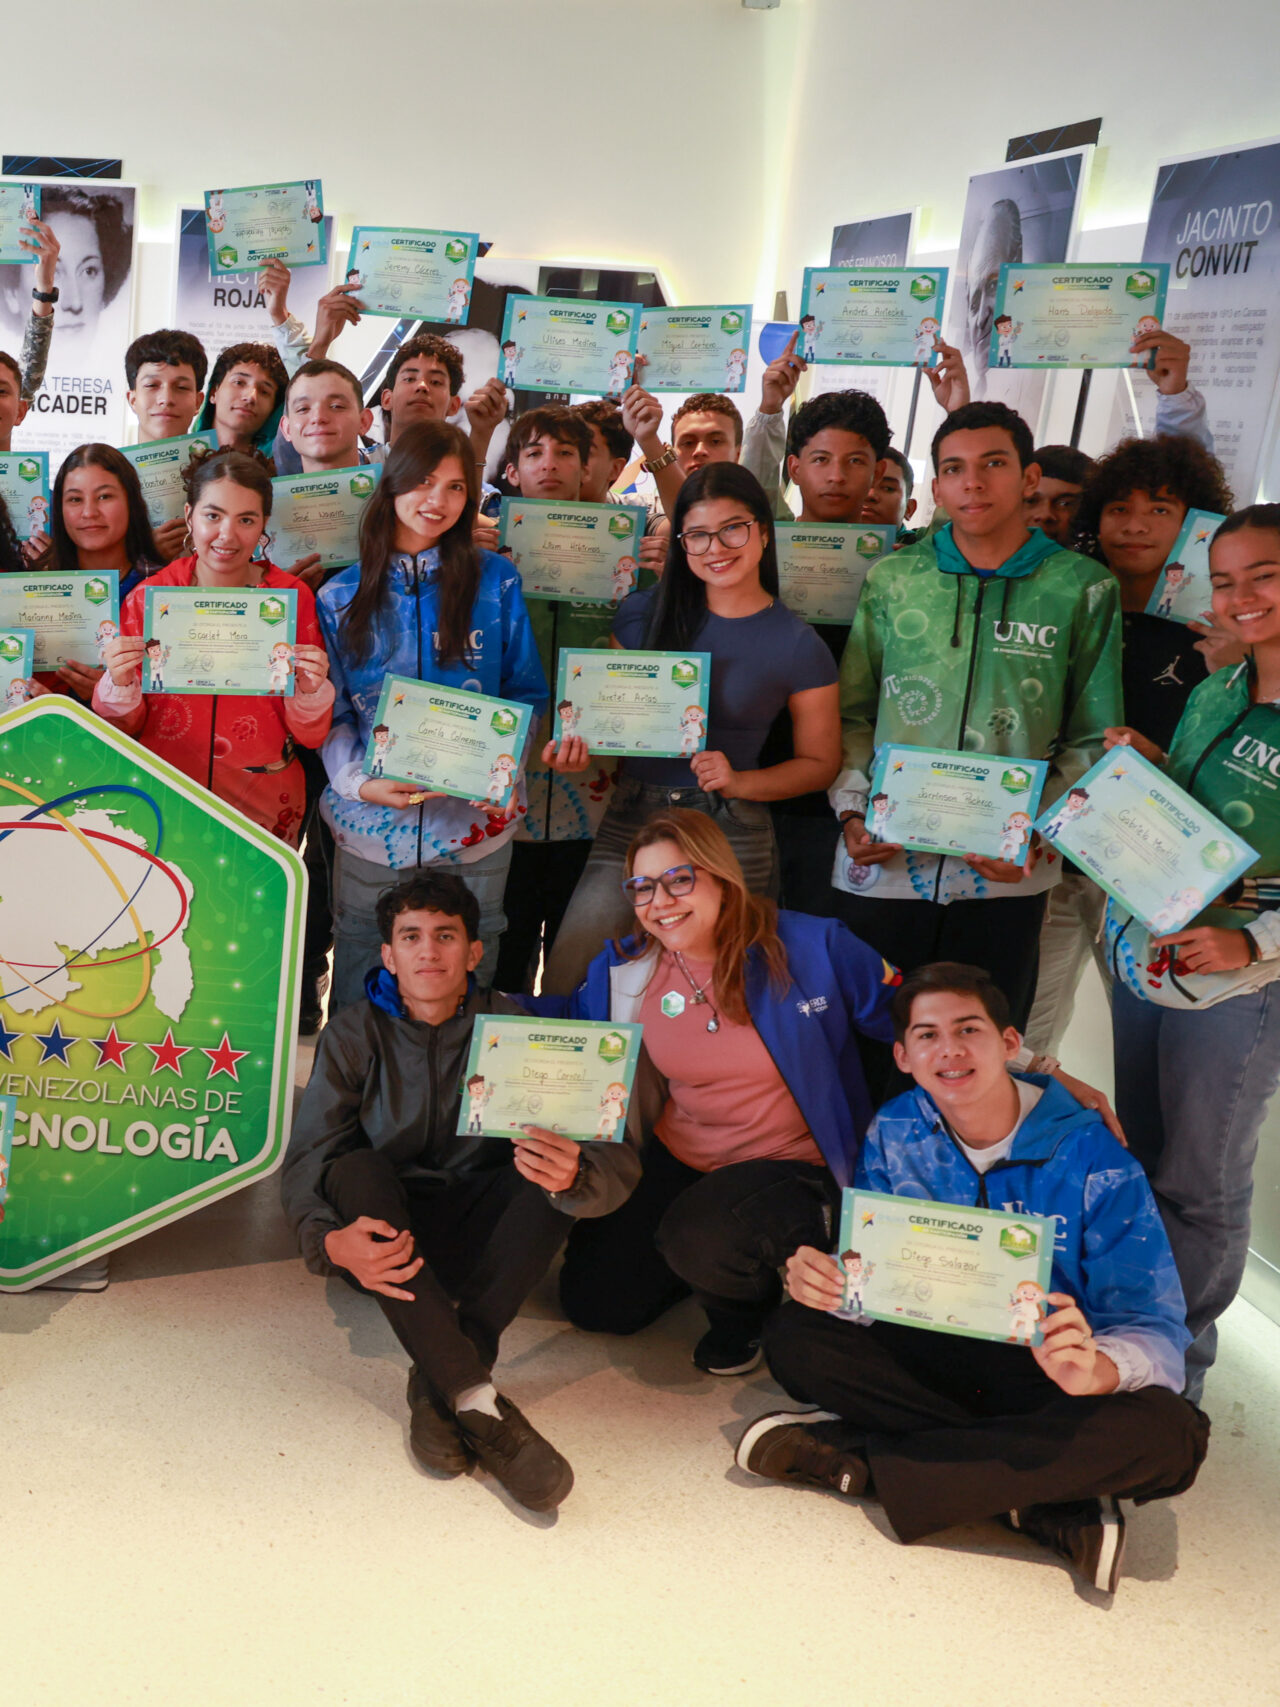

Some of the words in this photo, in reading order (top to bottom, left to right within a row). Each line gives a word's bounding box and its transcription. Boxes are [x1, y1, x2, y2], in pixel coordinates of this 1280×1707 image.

[1177, 200, 1273, 245] JACINTO
[391, 239, 437, 248] CERTIFICADO
[246, 251, 289, 261] CERTIFICADO
[1175, 240, 1259, 279] CONVIT
[848, 279, 900, 287] CERTIFICADO
[1052, 276, 1113, 284] CERTIFICADO
[213, 289, 267, 309] ROJA
[549, 309, 597, 319] CERTIFICADO
[667, 315, 712, 323] CERTIFICADO
[51, 376, 113, 394] TERESA
[31, 393, 108, 415] CADER
[135, 448, 180, 463] CERTIFICADO
[290, 481, 339, 494] CERTIFICADO
[546, 513, 598, 523] CERTIFICADO
[791, 534, 845, 544] CERTIFICADO
[23, 583, 74, 592] CERTIFICADO
[194, 601, 248, 610] CERTIFICADO
[993, 620, 1058, 648] UNC
[606, 662, 660, 672] CERTIFICADO
[428, 697, 482, 715] CERTIFICADO
[1232, 734, 1280, 778] UNC
[930, 761, 990, 775] CERTIFICADO
[1148, 788, 1200, 834] CERTIFICADO
[527, 1033, 588, 1045] CERTIFICADO
[205, 1089, 243, 1114] DE
[12, 1110, 238, 1164] CNOLOGÍA
[908, 1215, 984, 1234] CERTIFICADO
